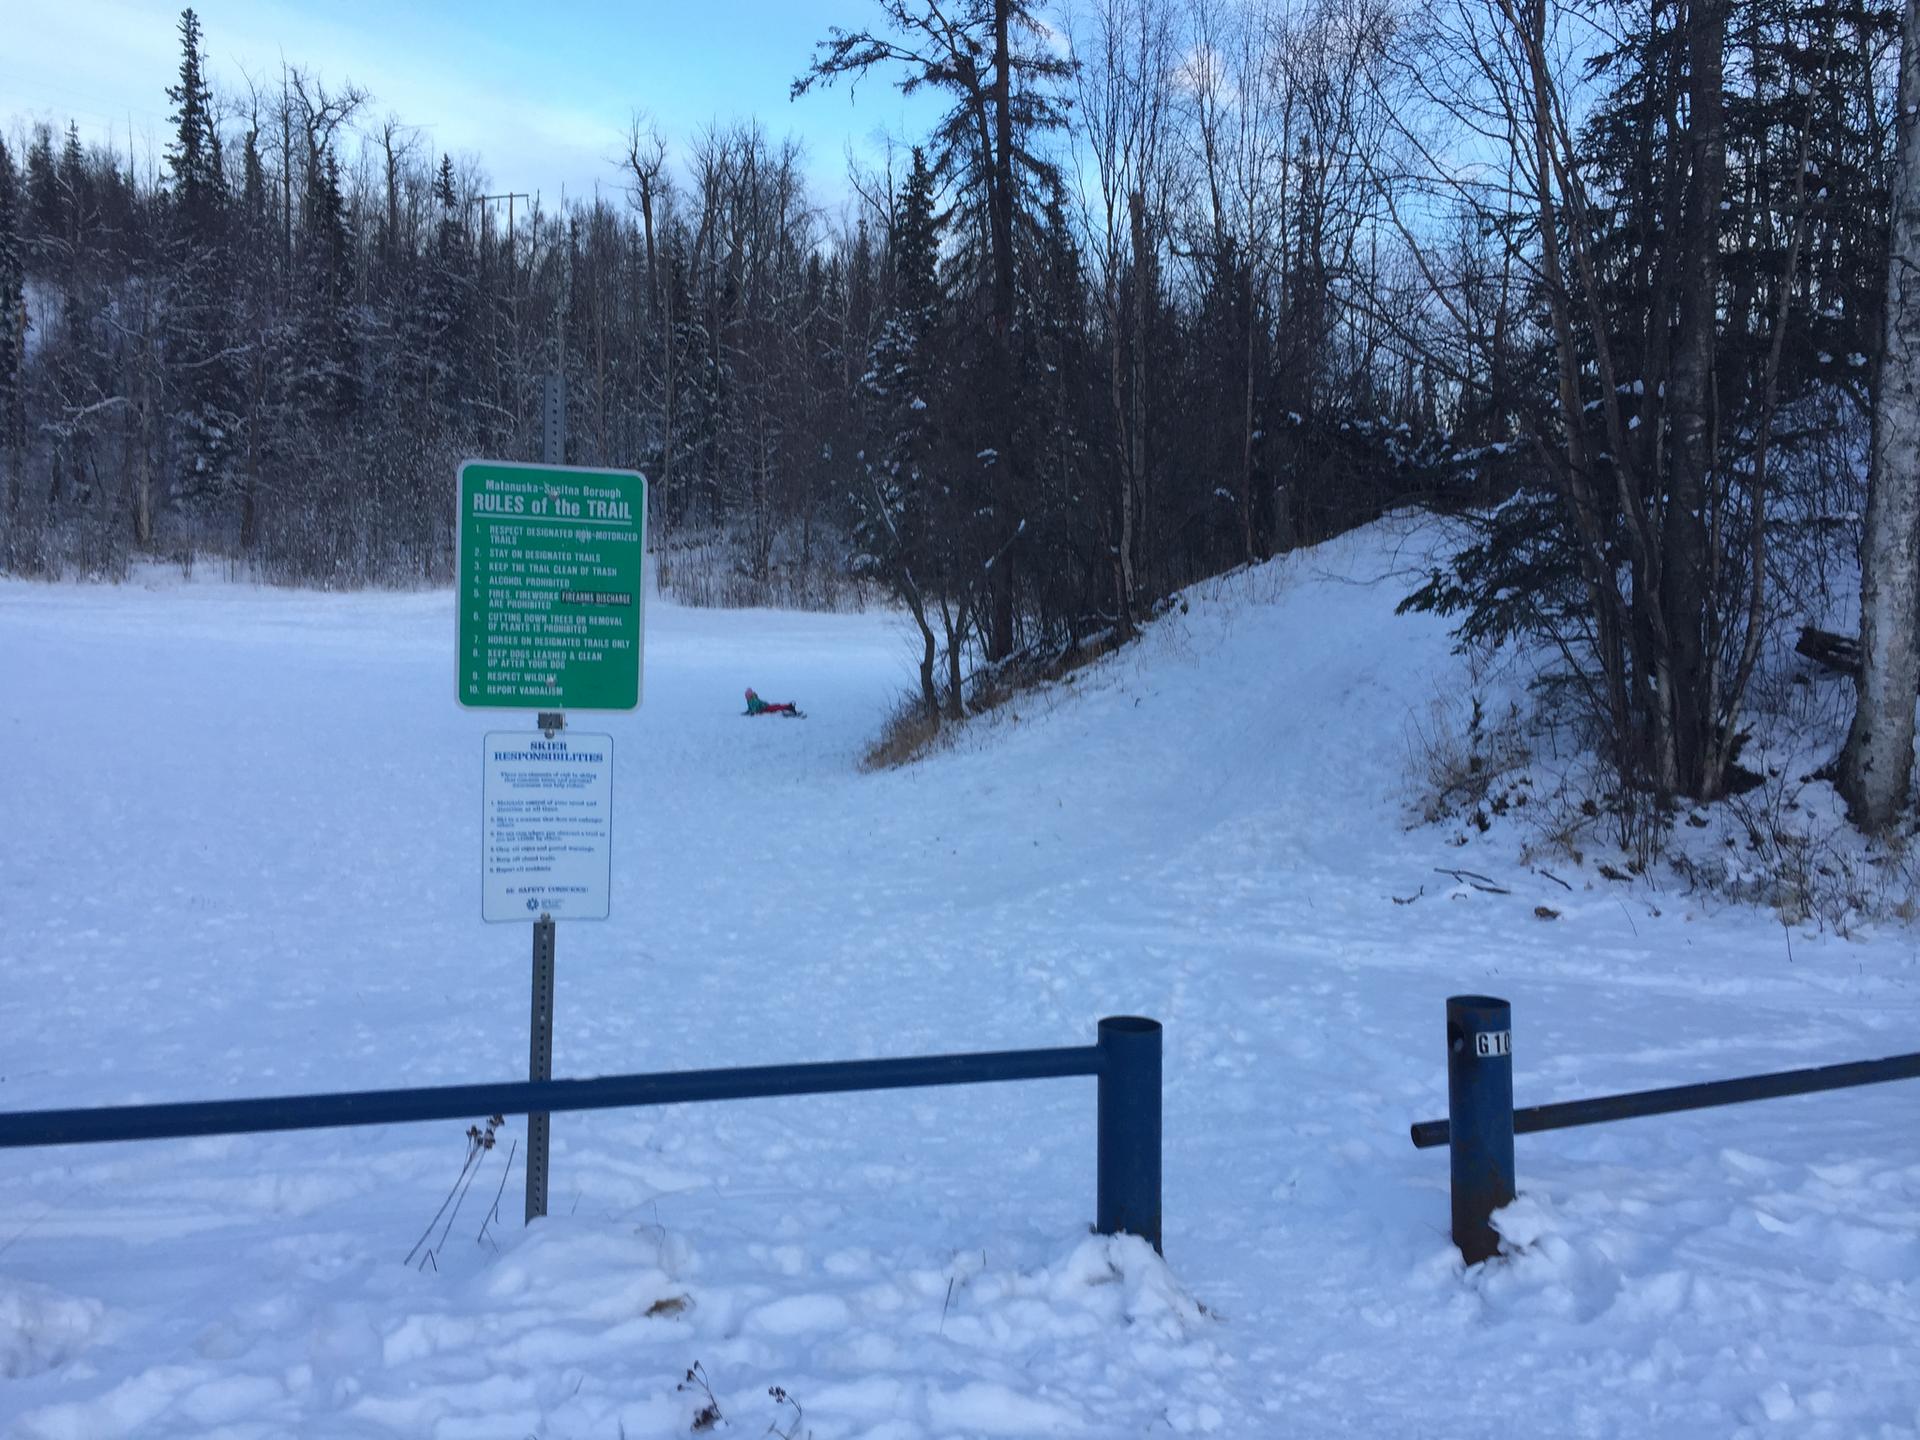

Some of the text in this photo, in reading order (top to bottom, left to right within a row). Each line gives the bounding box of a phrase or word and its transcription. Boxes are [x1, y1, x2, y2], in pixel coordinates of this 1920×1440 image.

[583, 485, 621, 499] Borough
[473, 493, 632, 520] RULES of the TRAIL
[489, 525, 523, 536] RESPECT
[526, 527, 573, 538] DESIGNATED
[575, 529, 638, 542] NON-MOTORIZED
[490, 535, 518, 545] TRAILS
[489, 548, 509, 558] STAY
[511, 549, 523, 559] ON
[525, 550, 572, 561] DESIGNATED
[575, 552, 601, 562] TRAILS
[488, 562, 509, 572] KEEP
[512, 563, 525, 573] THE
[529, 564, 550, 574] TRAIL
[553, 565, 578, 575] CLEAN
[580, 566, 589, 575] OF
[592, 567, 617, 577] TRASH
[489, 576, 522, 586] ALCOHOL
[525, 577, 570, 588] PROHIBITED
[515, 590, 560, 601] FIREWORKS
[562, 591, 595, 602] FIREARMS
[596, 593, 631, 604] DISCHARGE
[488, 599, 552, 610] ARE PROHIBITED
[488, 612, 521, 623] CUTTING
[524, 613, 547, 624] DOWN
[550, 614, 574, 625] TREES
[576, 616, 587, 625] OR
[589, 616, 623, 626] REMOVAL
[488, 623, 588, 634] OF PLANTS IS PROHIBITED
[488, 635, 518, 645] HORSES
[521, 636, 532, 646] ON
[534, 637, 581, 647] DESIGNATED
[583, 638, 609, 648] TRAILS
[612, 639, 630, 649] ONLY
[488, 649, 508, 659] KEEP
[510, 650, 531, 660] DOGS
[533, 650, 567, 661] LEASHED
[578, 652, 602, 661] CLEAN
[488, 659, 566, 670] UP AFTER YOUR DOG
[487, 672, 521, 682] RESPECT
[469, 684, 564, 697] 10. REPORT VANDALISM
[530, 741, 567, 751] SKIER
[494, 751, 604, 763] RESPONSIBILITIES
